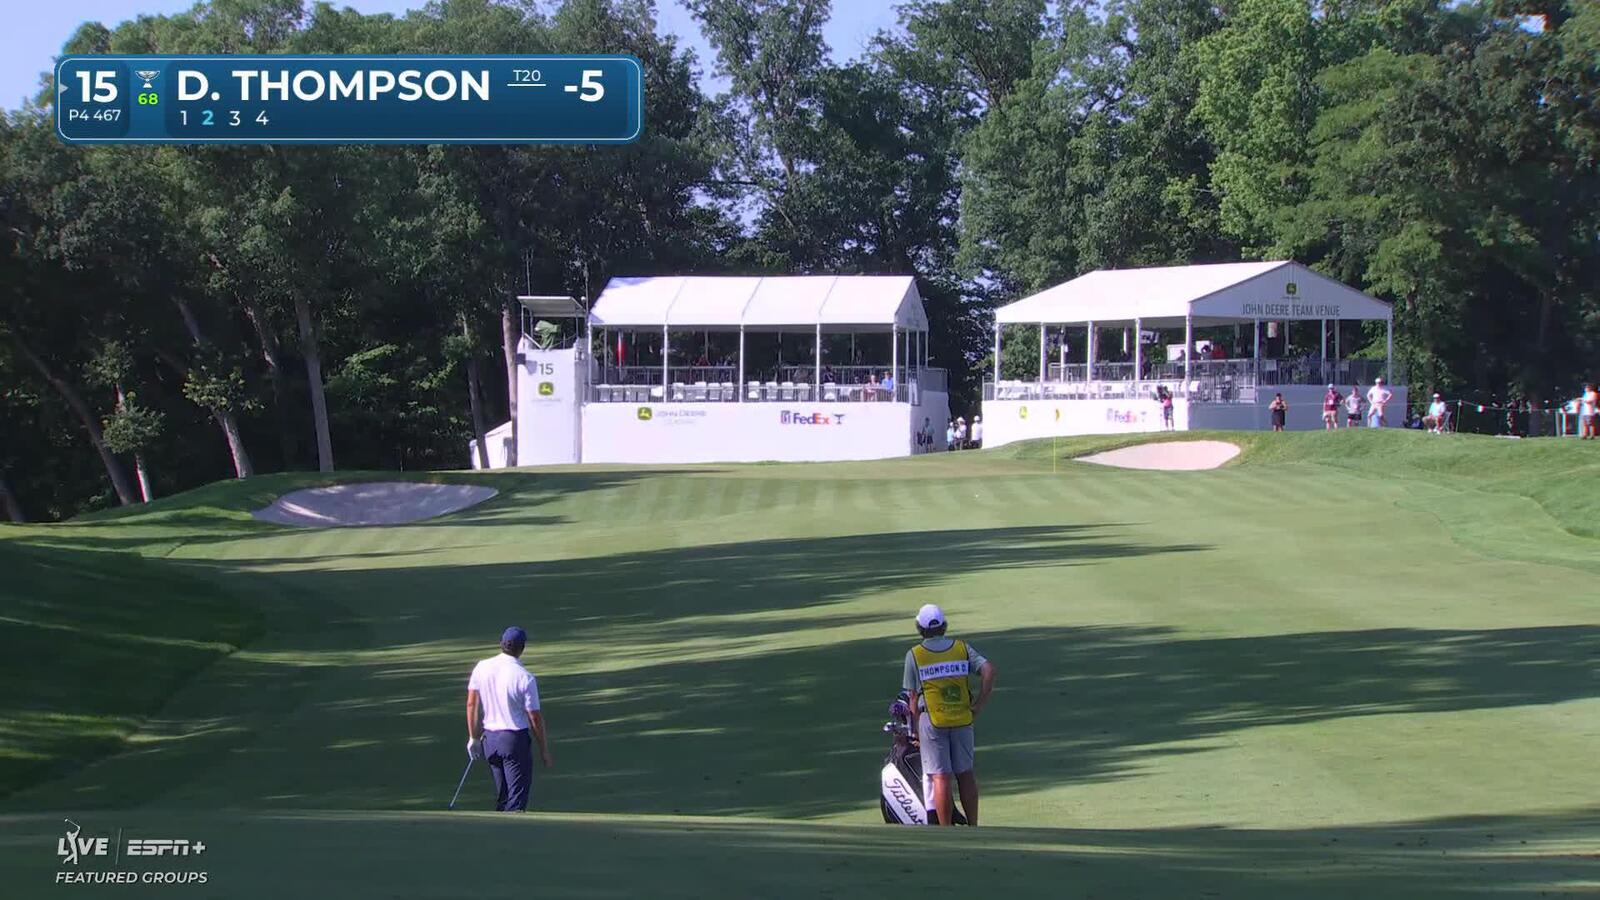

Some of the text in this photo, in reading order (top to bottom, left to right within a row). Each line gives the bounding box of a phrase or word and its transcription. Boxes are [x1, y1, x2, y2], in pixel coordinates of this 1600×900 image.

[1242, 303, 1340, 317] JOHN DEERE TEAM VENUE
[538, 363, 554, 375] 15
[793, 412, 829, 424] FedEx
[919, 664, 960, 677] THOMPSON
[885, 778, 925, 825] Titleist
